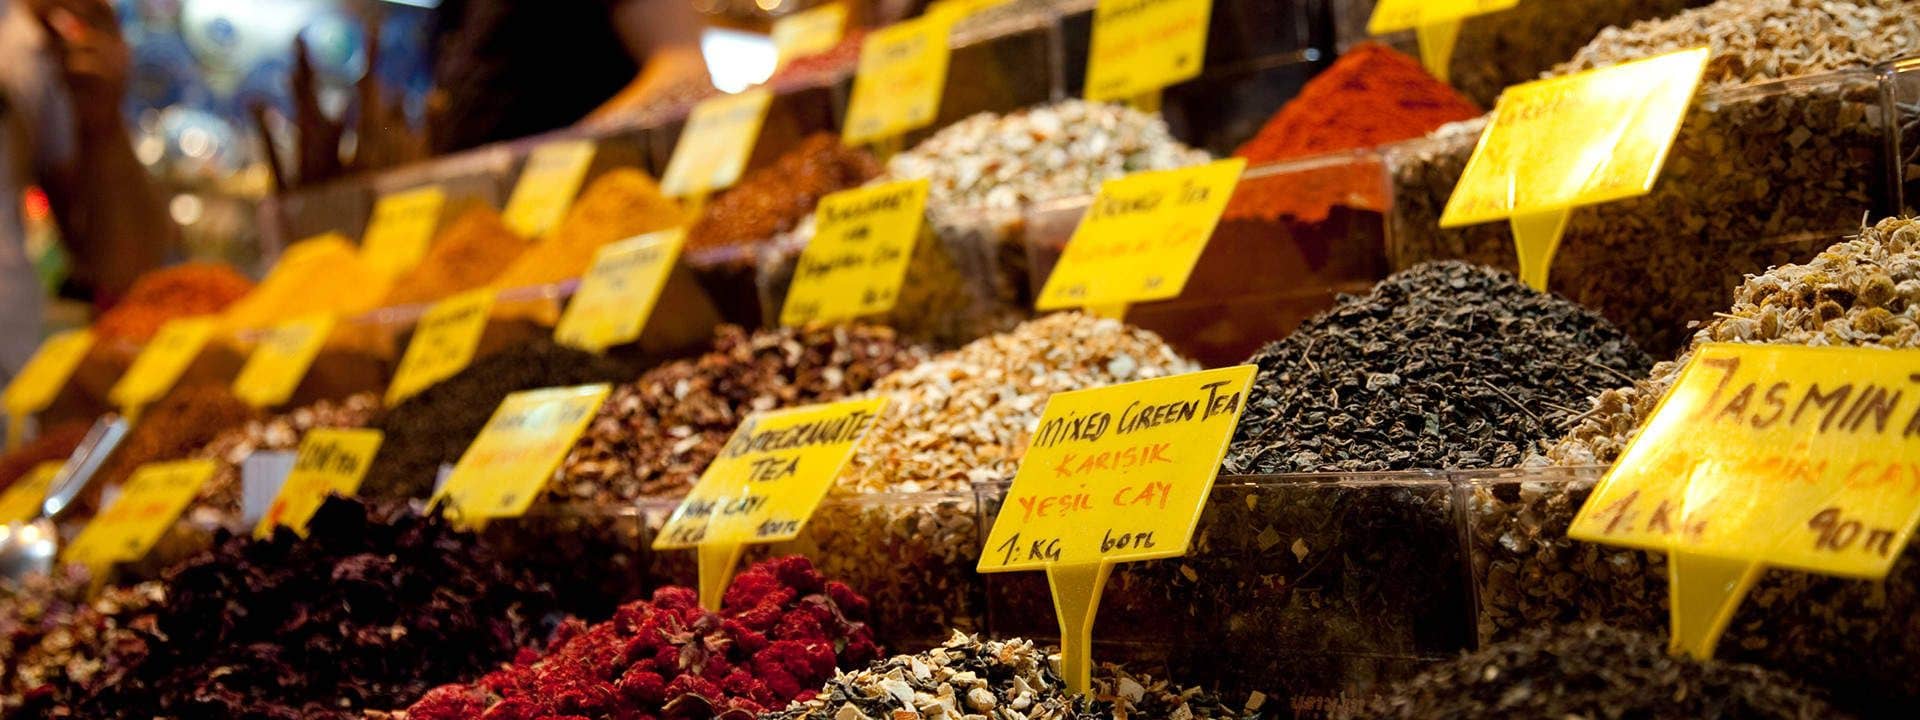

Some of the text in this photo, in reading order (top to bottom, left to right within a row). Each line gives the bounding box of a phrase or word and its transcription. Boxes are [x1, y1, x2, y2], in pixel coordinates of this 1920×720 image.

[1116, 400, 1200, 435] GREEN
[1200, 380, 1241, 422] TEA
[1692, 356, 1903, 434] JASMIN
[750, 456, 800, 481] TEA
[1027, 538, 1061, 562] KG
